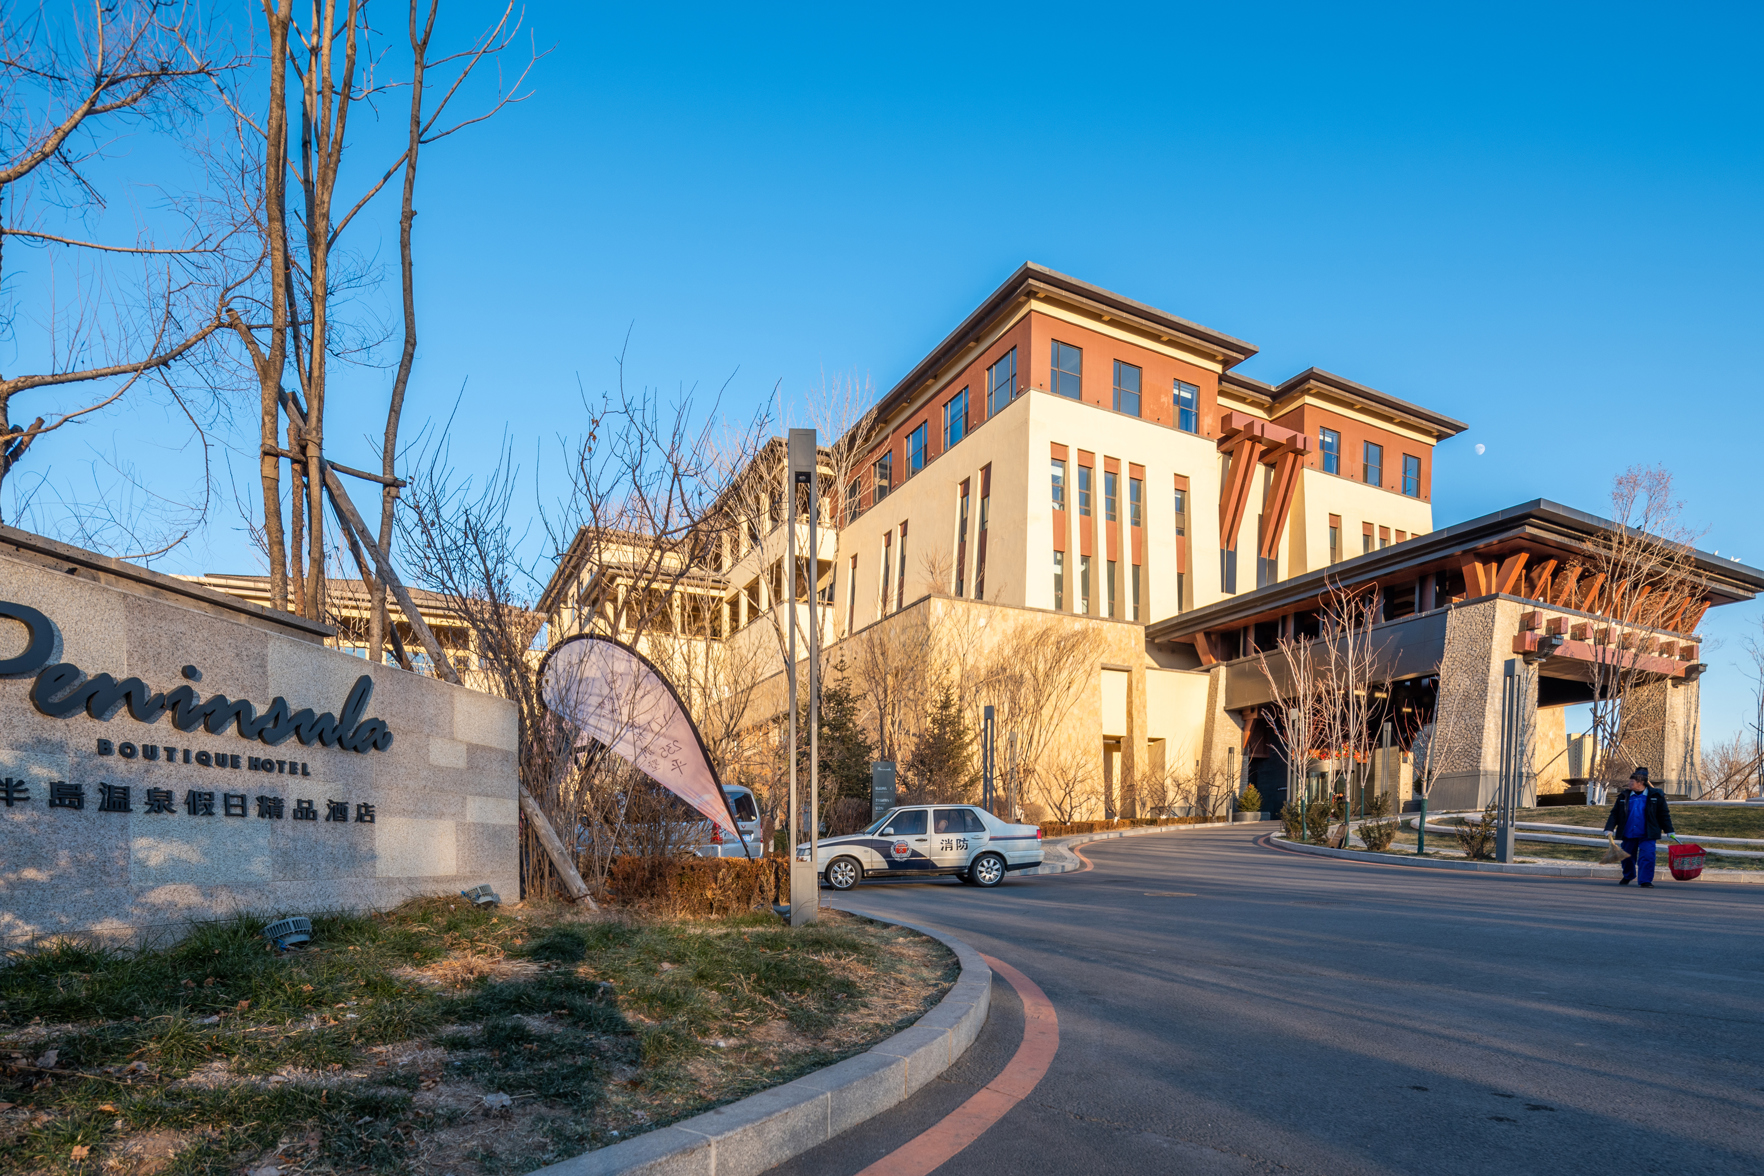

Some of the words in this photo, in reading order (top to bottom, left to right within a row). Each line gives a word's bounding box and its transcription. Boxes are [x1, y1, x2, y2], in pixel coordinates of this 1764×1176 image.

[97, 738, 241, 770] BOUTIQUE
[247, 755, 311, 777] HOTEL
[940, 837, 969, 851] 消防
